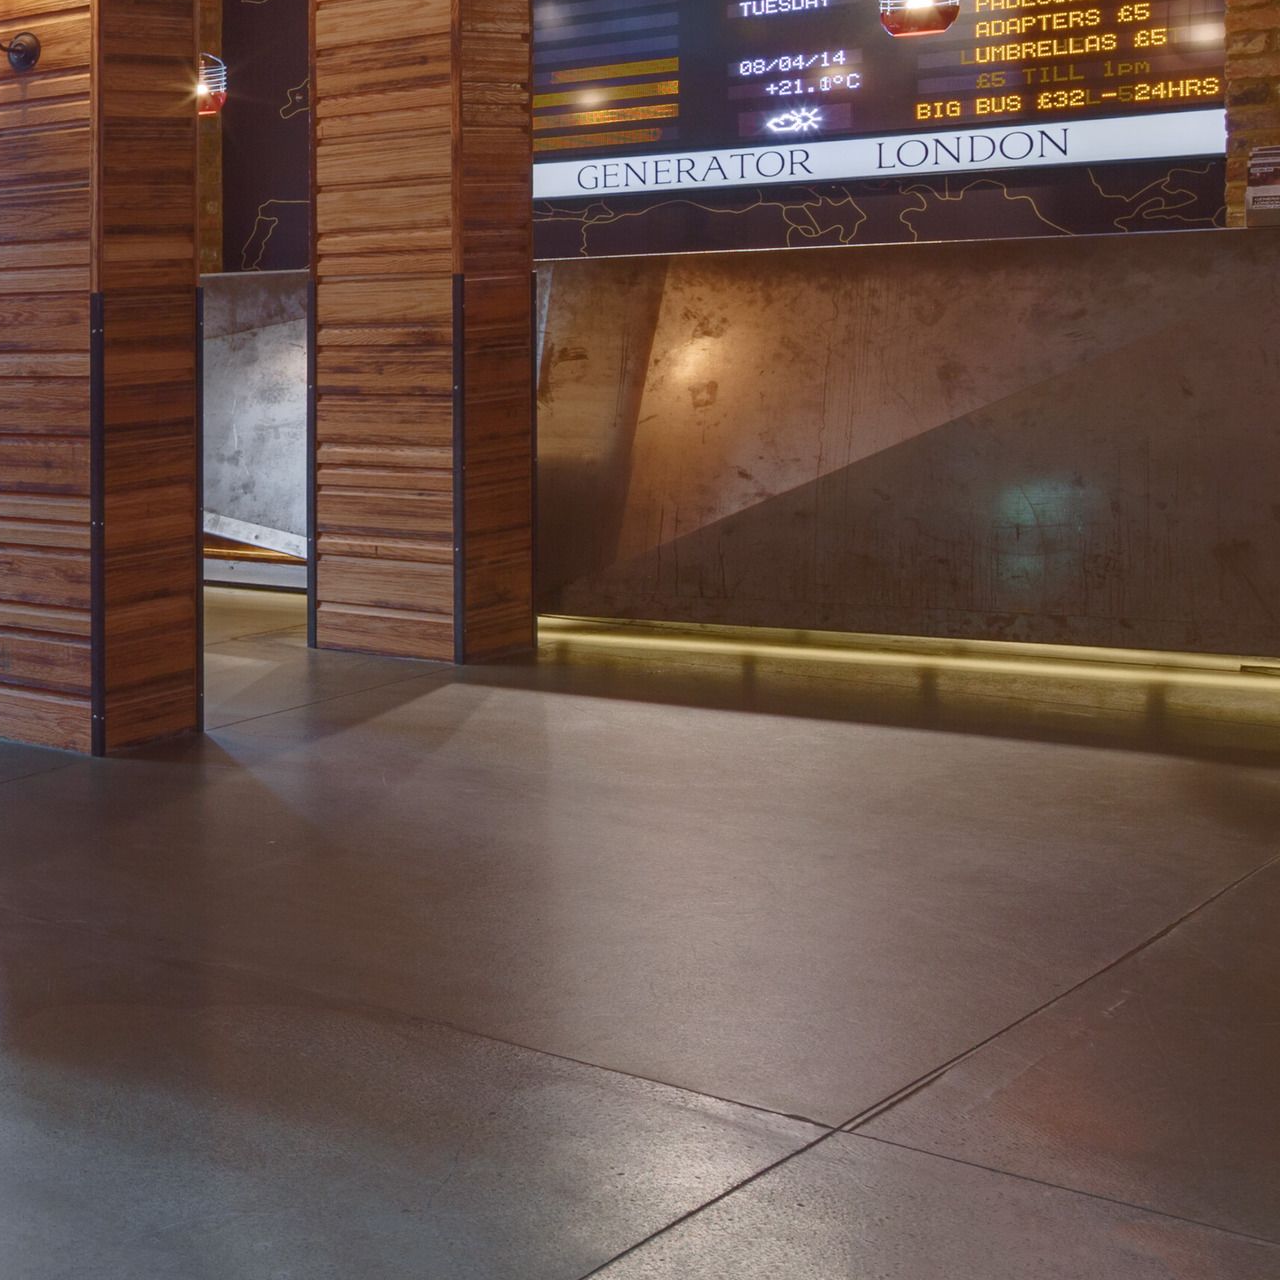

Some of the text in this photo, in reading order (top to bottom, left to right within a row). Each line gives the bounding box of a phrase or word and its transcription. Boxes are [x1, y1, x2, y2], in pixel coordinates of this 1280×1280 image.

[976, 3, 1151, 38] ADAPTERS £5
[740, 50, 845, 75] 08/04/14
[976, 28, 1167, 63] UMBRELLAS £5
[916, 100, 961, 120] BIG
[976, 96, 1021, 114] BUS
[1038, 90, 1085, 110] £32
[1134, 77, 1220, 100] 24HRS
[577, 128, 1069, 190] GENERATOR LONDON
